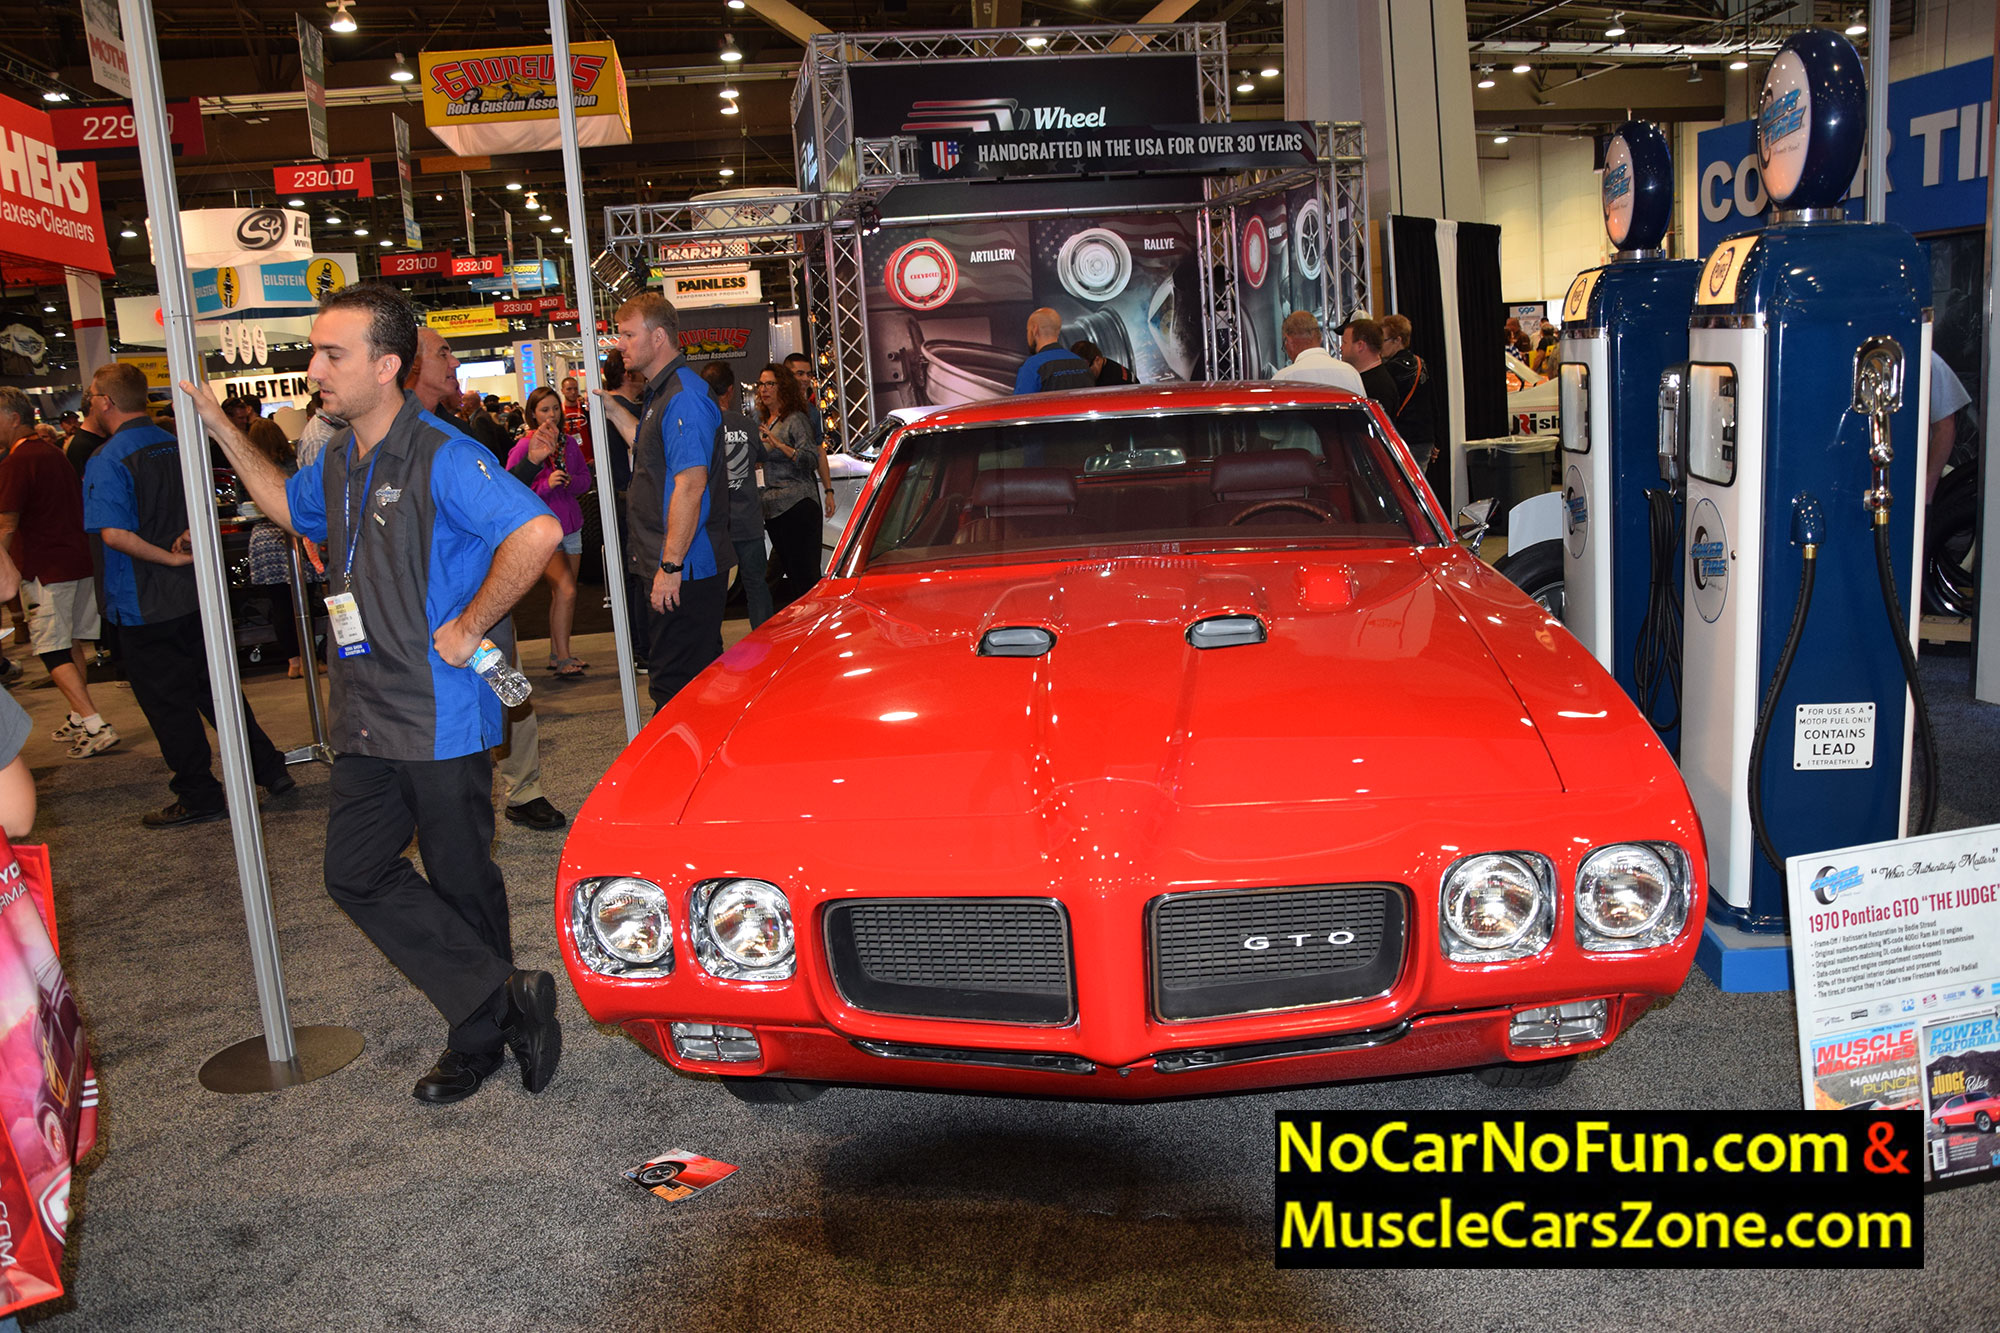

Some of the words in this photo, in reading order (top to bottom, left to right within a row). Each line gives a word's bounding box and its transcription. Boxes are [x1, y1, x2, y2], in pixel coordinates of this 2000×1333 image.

[431, 55, 606, 100] GOODGUS
[447, 102, 470, 115] Rod
[471, 103, 481, 113] &
[481, 100, 525, 113] Custom
[527, 95, 596, 110] Assotion
[1034, 106, 1106, 130] Wheel
[978, 141, 1083, 162] HANDCRAFTED
[1087, 140, 1101, 157] IN
[1105, 139, 1131, 156] THE
[1135, 137, 1164, 156] USA
[1168, 137, 1195, 154] FOR
[1198, 136, 1234, 153] OVER
[1237, 135, 1256, 152] 30
[1259, 134, 1303, 151] YEARS
[294, 168, 354, 188] 23000
[667, 246, 721, 261] MARCH
[1144, 238, 1175, 250] RALLYE
[396, 257, 437, 272] 23100
[456, 260, 493, 272] 23200
[970, 249, 1016, 263] ARTILLERY
[195, 283, 218, 298] BILSTEIN
[263, 274, 306, 287] BILSTEIN
[677, 277, 746, 292] PAINLESS
[503, 302, 532, 313] 23300
[555, 310, 578, 319] 23500
[431, 313, 470, 323] ENERGY
[678, 328, 750, 349] OODGUYS
[687, 353, 710, 361] Custom
[711, 351, 746, 360] Association
[1702, 560, 1727, 577] TIRE
[1827, 707, 1842, 715] USE
[1804, 729, 1866, 740] CONTAINS
[1813, 743, 1856, 756] LEAD
[1810, 865, 1860, 891] COKER
[1907, 861, 1957, 877] Authenticity
[1829, 873, 1864, 895] TIRE
[1809, 911, 1840, 933] 1970
[1842, 905, 1891, 927] Pontiac
[1893, 897, 1919, 918] GTO
[1244, 931, 1355, 950] GTO
[1814, 948, 1835, 958] Original
[1836, 941, 1882, 954] numbers-matching
[1920, 931, 1931, 939] Ram
[1946, 926, 1963, 935] engine
[1842, 933, 1868, 943] Rotisserie
[1868, 927, 1897, 938] Restoration
[1898, 926, 1904, 934] by
[1815, 958, 1836, 969] Original
[1837, 951, 1882, 964] numbers-matching
[1922, 939, 1941, 948] 4-speed
[1942, 934, 1974, 945] transmission
[1842, 964, 1859, 973] correct
[1860, 961, 1877, 970] engine
[1878, 955, 1911, 967] compartment
[1912, 949, 1942, 960] components
[1846, 973, 1865, 983] original
[1866, 969, 1885, 978] interior
[1885, 964, 1905, 975] cleaned
[1916, 959, 1940, 970] preserved
[1818, 990, 1827, 998] The
[1847, 984, 1863, 993] course
[1912, 970, 1935, 980] Firestone
[1936, 967, 1949, 975] Wide
[1949, 965, 1960, 973] Oval
[1930, 1019, 1993, 1044] POWER
[1817, 1028, 1913, 1063] MUSCLE
[1929, 1032, 2000, 1056] PERFORMA
[1818, 1044, 1915, 1077] MACHINES
[1850, 1065, 1917, 1087] HAWAIIAN
[1863, 1074, 1918, 1095] PUNCH
[1932, 1071, 1966, 1096] JUDGE
